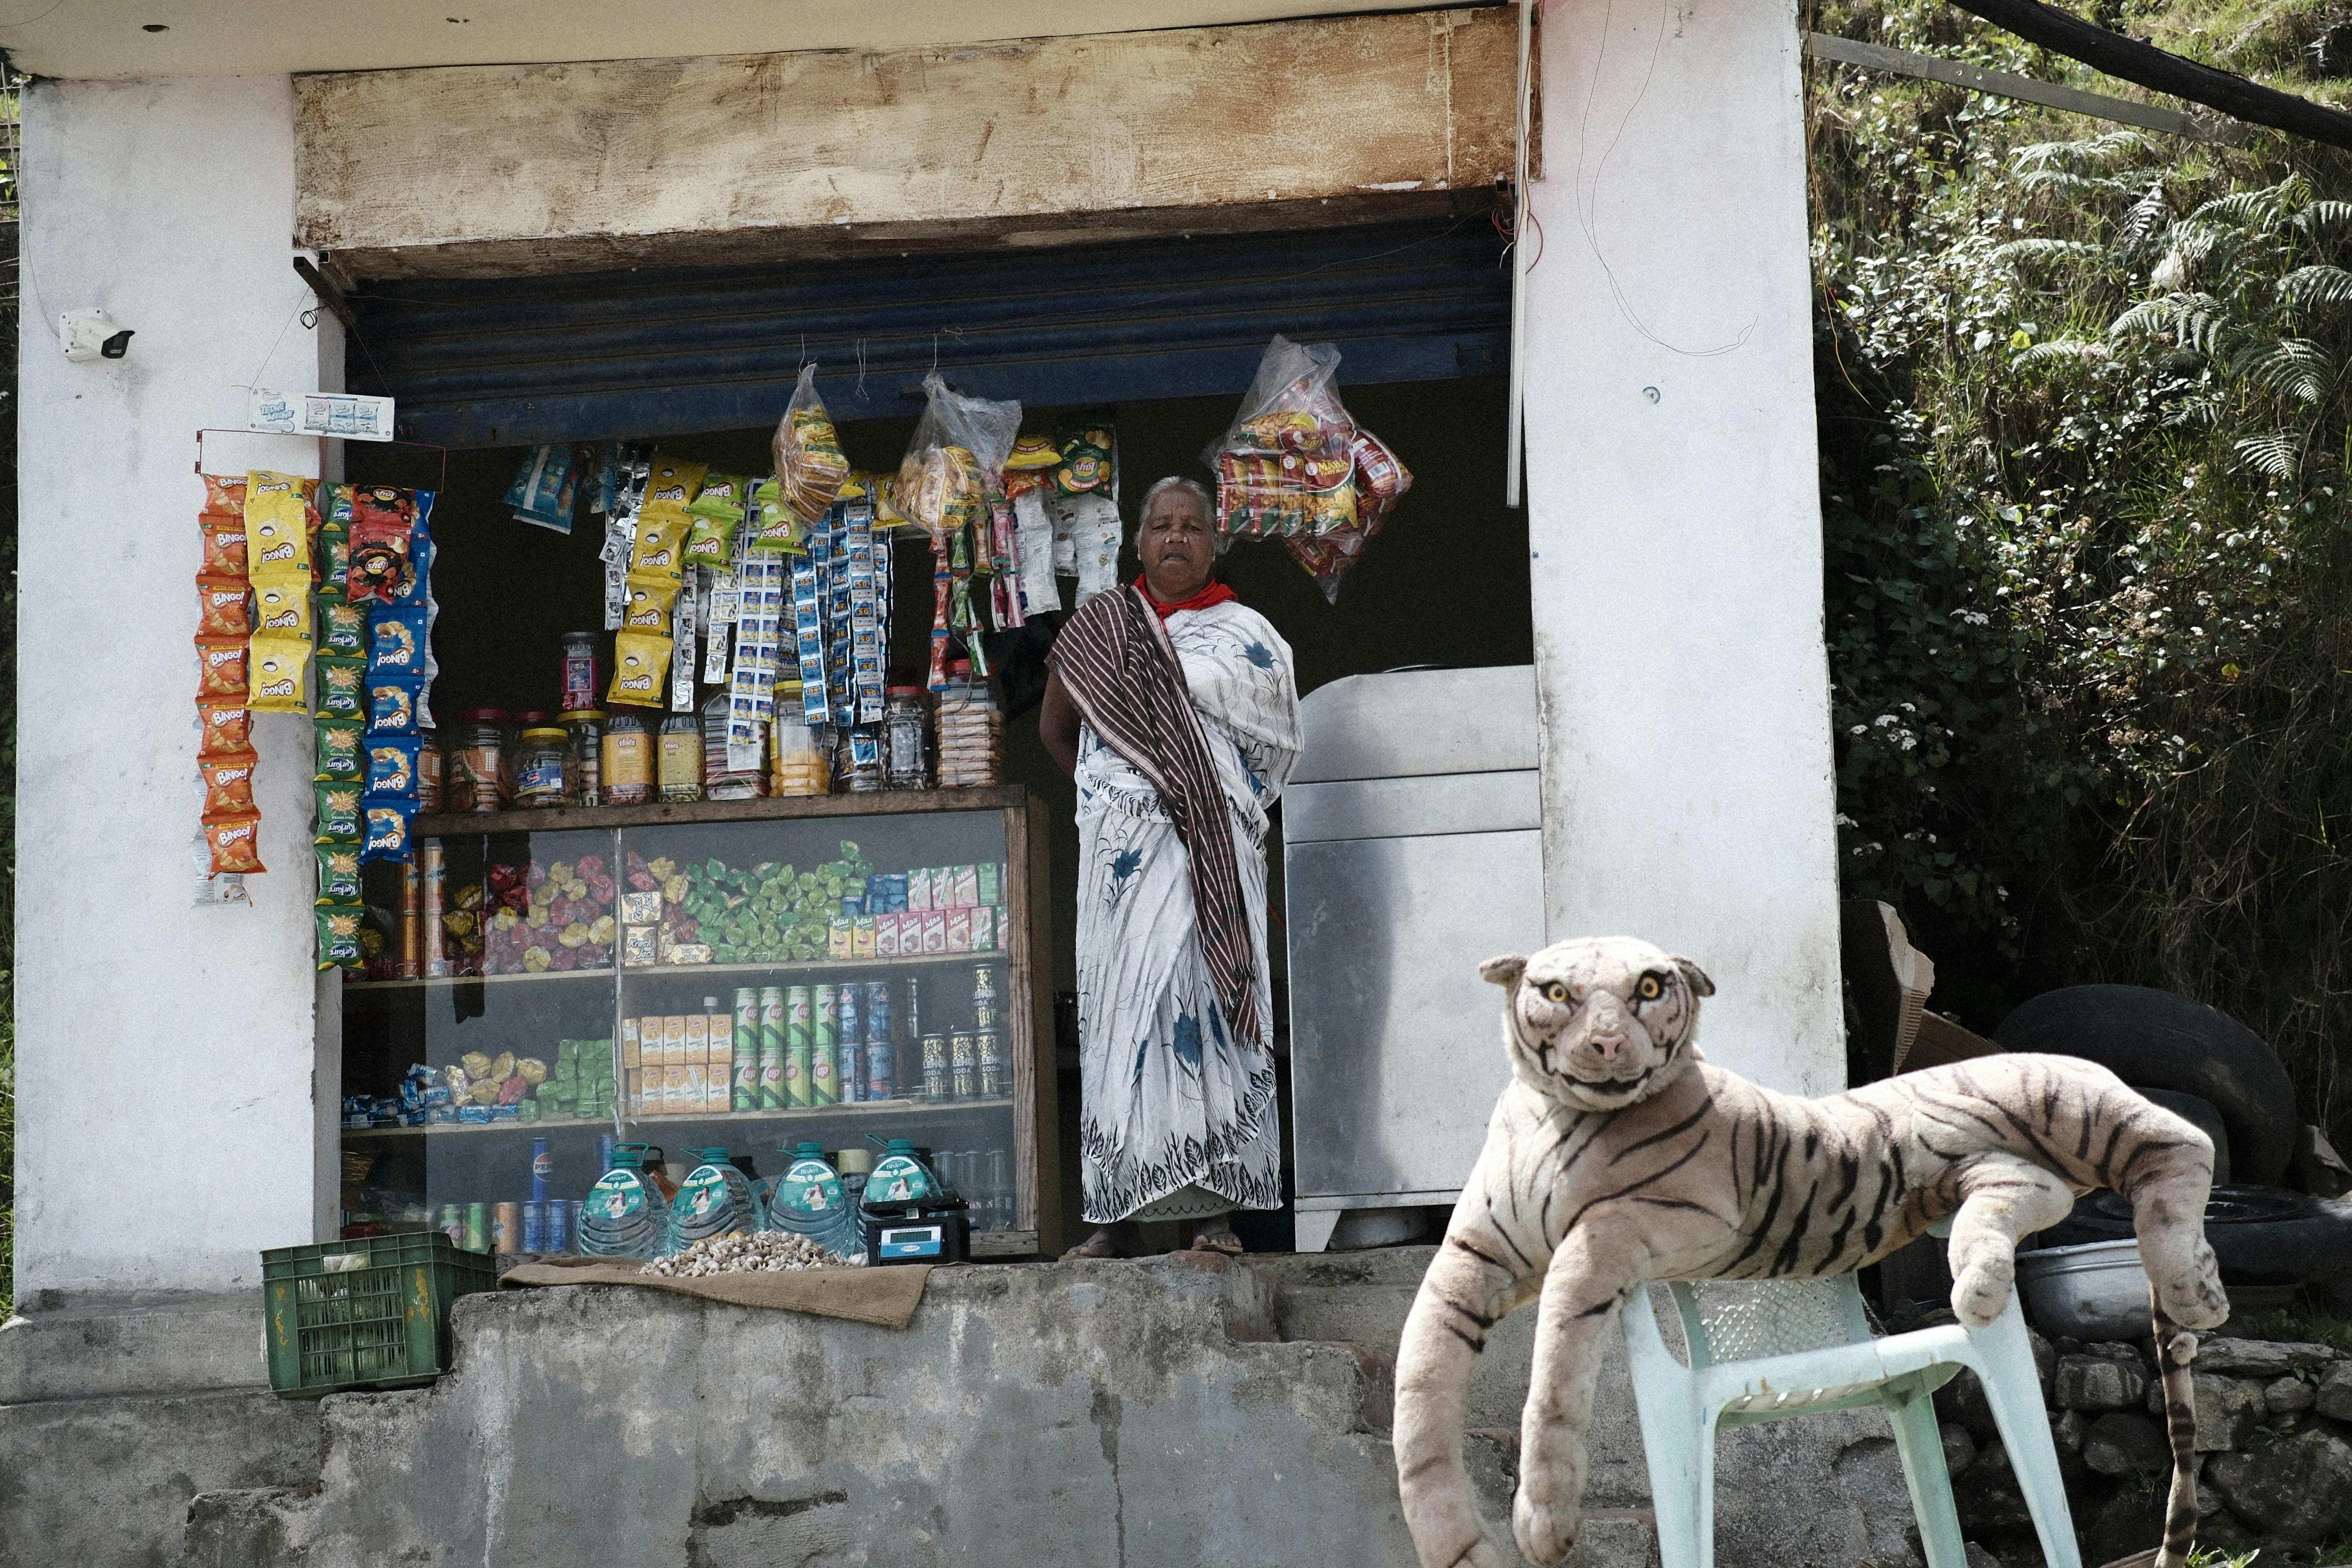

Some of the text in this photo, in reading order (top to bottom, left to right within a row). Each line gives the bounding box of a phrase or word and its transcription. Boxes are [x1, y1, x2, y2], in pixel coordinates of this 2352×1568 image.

[1318, 460, 1349, 471] MAHA
[257, 483, 288, 495] BINGO!
[653, 486, 683, 501] BINGO!
[760, 524, 789, 539] BINGO!
[689, 540, 718, 554] BINGO!
[261, 546, 293, 564] BINGO!
[640, 553, 670, 567] BINGO!
[394, 585, 410, 597] BIN
[213, 591, 245, 606] BINGO!
[265, 613, 297, 630] BINGO!
[628, 612, 659, 626] BINGO!
[329, 634, 360, 647] Kurkure
[210, 649, 242, 666] BINGO!
[377, 650, 410, 666] BINGO!
[259, 682, 292, 698] BINGO!
[620, 676, 651, 691] BINGO!
[326, 696, 357, 709] Kurkure
[213, 709, 245, 725] BINGO!
[374, 712, 406, 729] BINGO!
[326, 759, 357, 771] Kurkure
[217, 768, 248, 785] BINGO!
[373, 774, 405, 791] BINGO!
[219, 826, 250, 845] BINGO!
[328, 822, 357, 835] Kurkure
[368, 835, 400, 851] BINGO!
[957, 869, 973, 883] Maa
[329, 884, 358, 896] Kurkure
[633, 896, 643, 921] Krack
[643, 893, 653, 912] Jack
[833, 918, 849, 927] Maa
[856, 917, 872, 927] Maa
[879, 919, 895, 932] Maa
[902, 917, 918, 930] Maa
[926, 915, 942, 928] Maa
[950, 913, 966, 926] Maa
[628, 938, 653, 948] Krack
[329, 946, 358, 959] Kurkure
[636, 949, 655, 958] Jack
